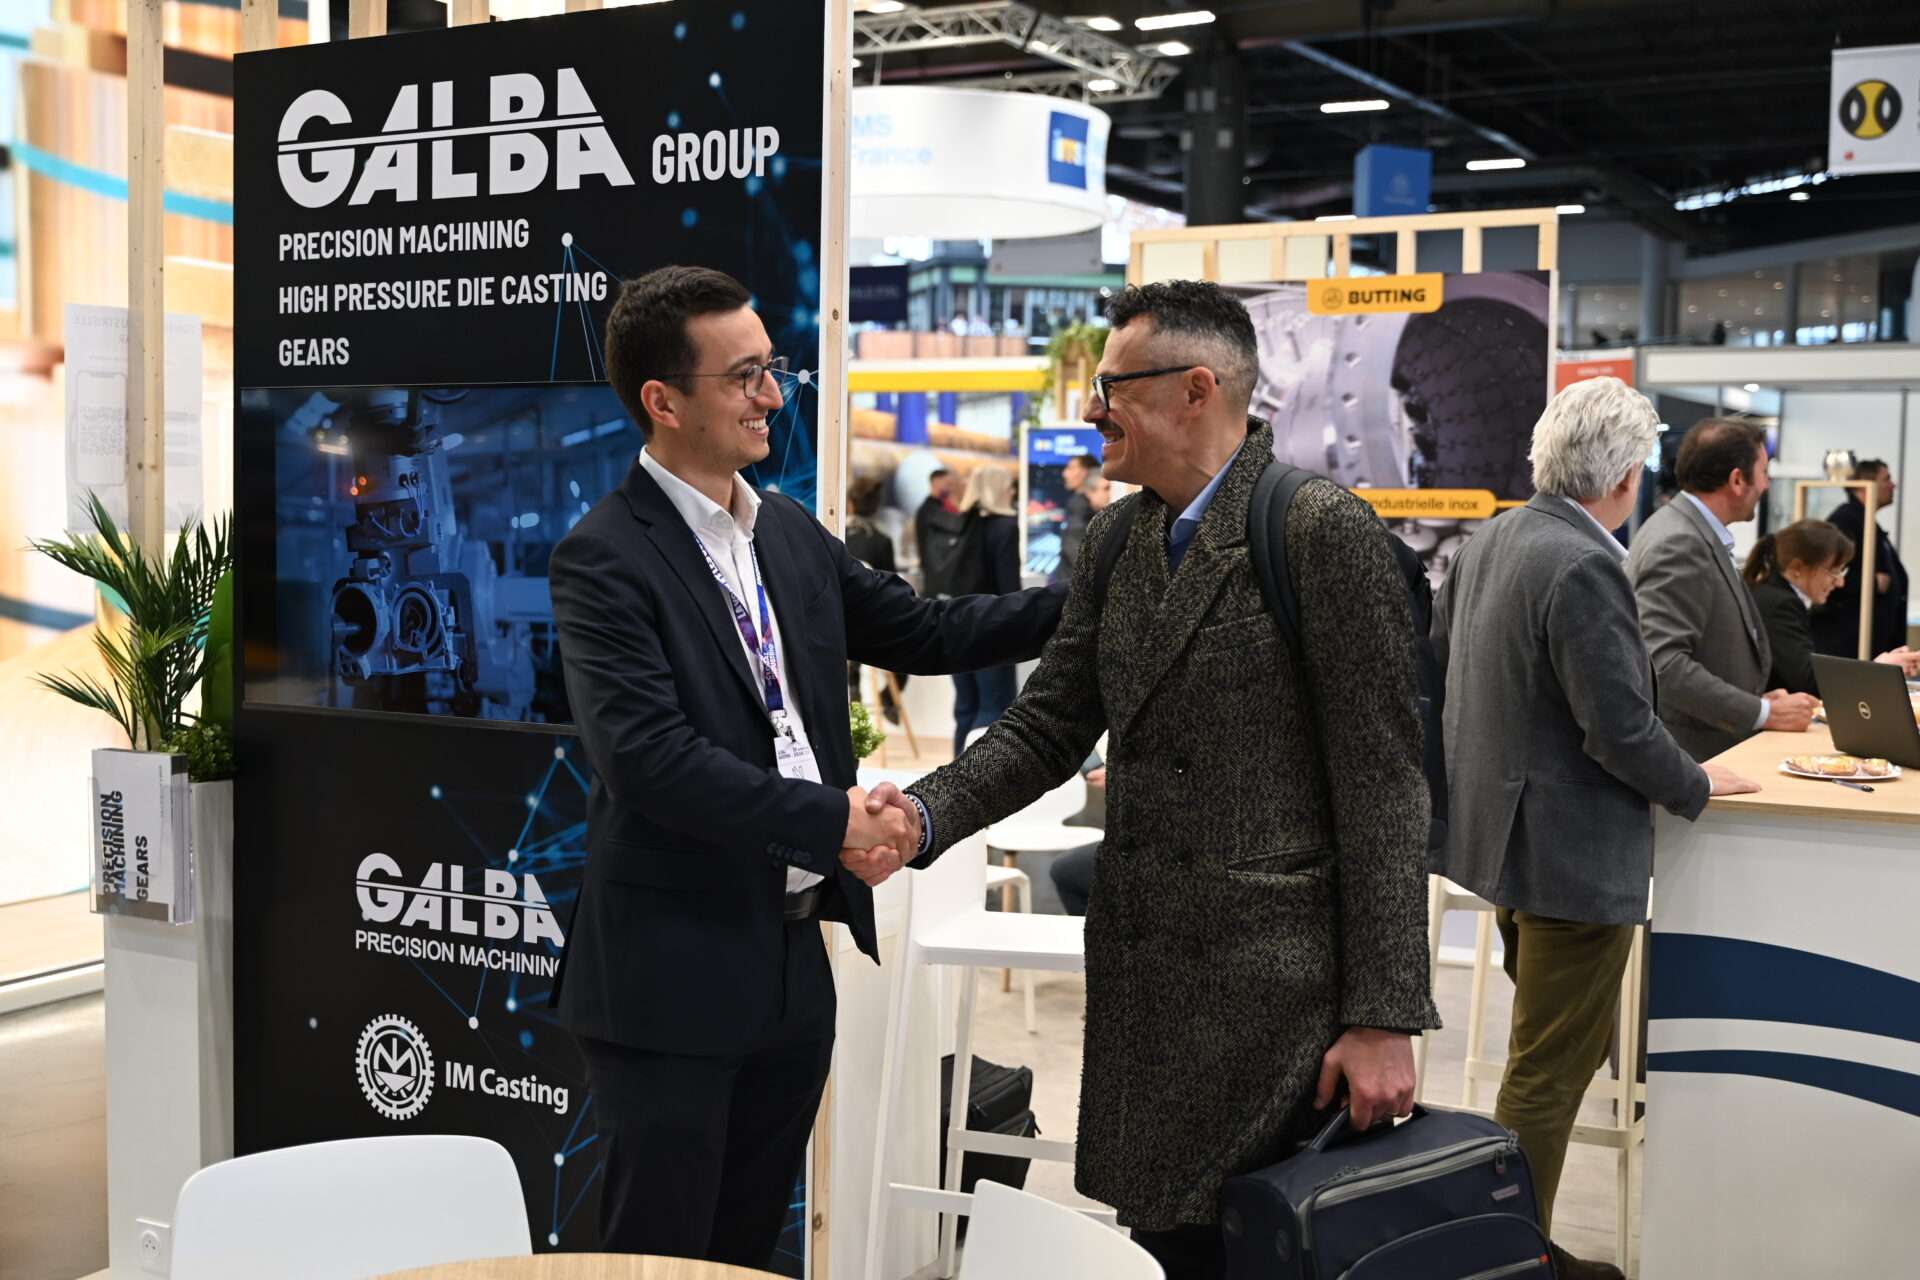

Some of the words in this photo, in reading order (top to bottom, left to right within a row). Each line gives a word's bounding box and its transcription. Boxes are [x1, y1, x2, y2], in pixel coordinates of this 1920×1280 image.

[277, 67, 635, 208] GALBA
[652, 126, 780, 184] GROUP
[279, 227, 393, 261] PRECISION
[400, 218, 529, 255] MACHINING
[279, 285, 328, 314] HIGH
[334, 278, 452, 311] PRESSURE
[457, 276, 495, 307] DIE
[501, 271, 607, 304] CASTING
[1348, 288, 1426, 305] BUTTING
[279, 337, 350, 367] GEARS
[1374, 497, 1444, 510] ndustrielle
[1448, 498, 1479, 511] inox
[101, 793, 116, 895] PRECISION
[111, 791, 127, 898] MACHINING
[135, 834, 149, 901] GEARS
[356, 853, 565, 947] GALBA
[356, 930, 454, 963] PRECISION
[445, 1060, 475, 1091] IM
[479, 1068, 569, 1114] Casting
